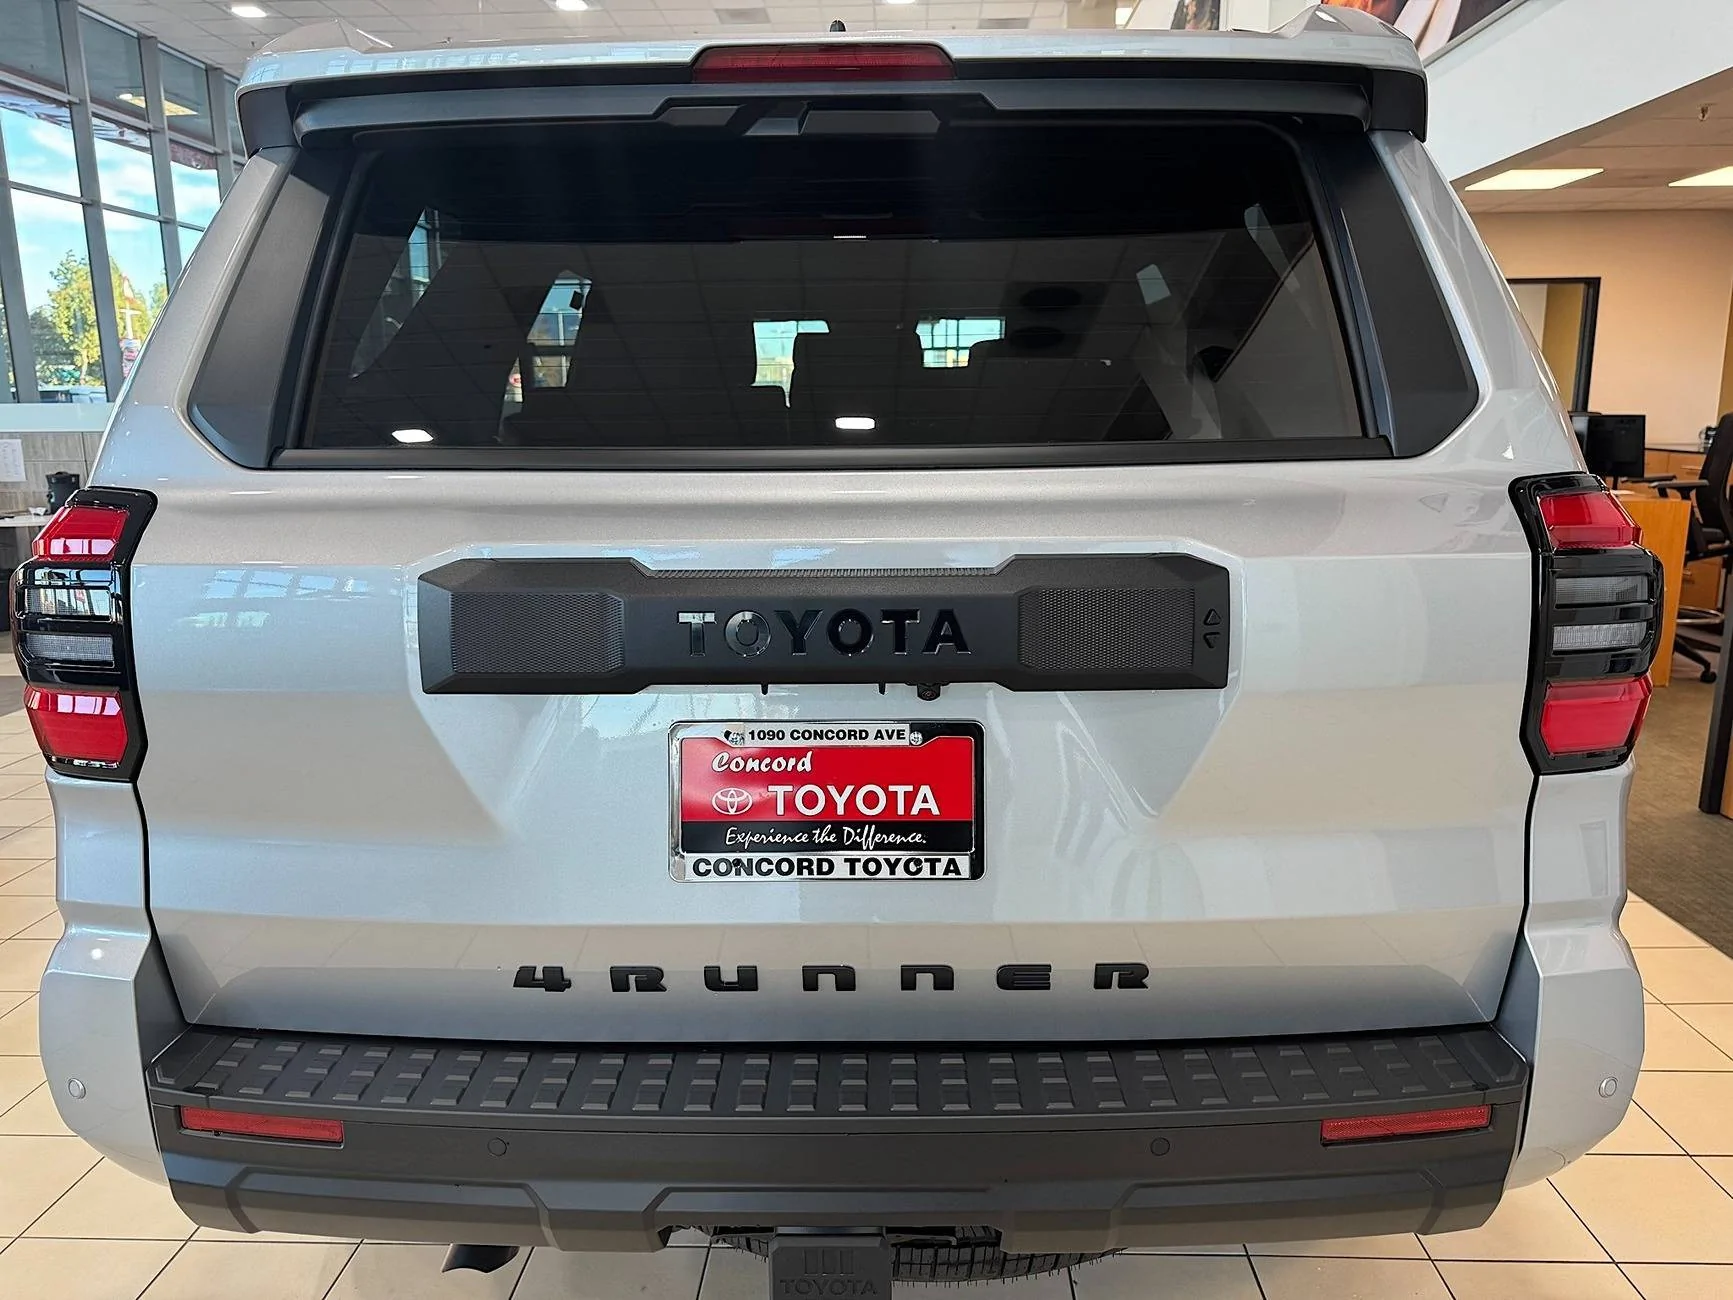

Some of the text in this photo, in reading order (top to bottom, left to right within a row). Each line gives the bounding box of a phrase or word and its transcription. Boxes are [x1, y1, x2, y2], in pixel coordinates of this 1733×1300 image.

[677, 609, 971, 657] TOYOTA
[748, 729, 906, 741] 1090 CONCORD AVE
[711, 751, 813, 773] Concord
[768, 784, 941, 816] TOYOTA
[725, 824, 927, 851] Experience the Difference.
[692, 857, 962, 877] CONCORD TOYOTA
[513, 963, 1150, 991] 4RUNNER
[779, 1278, 878, 1296] TOYOTA
